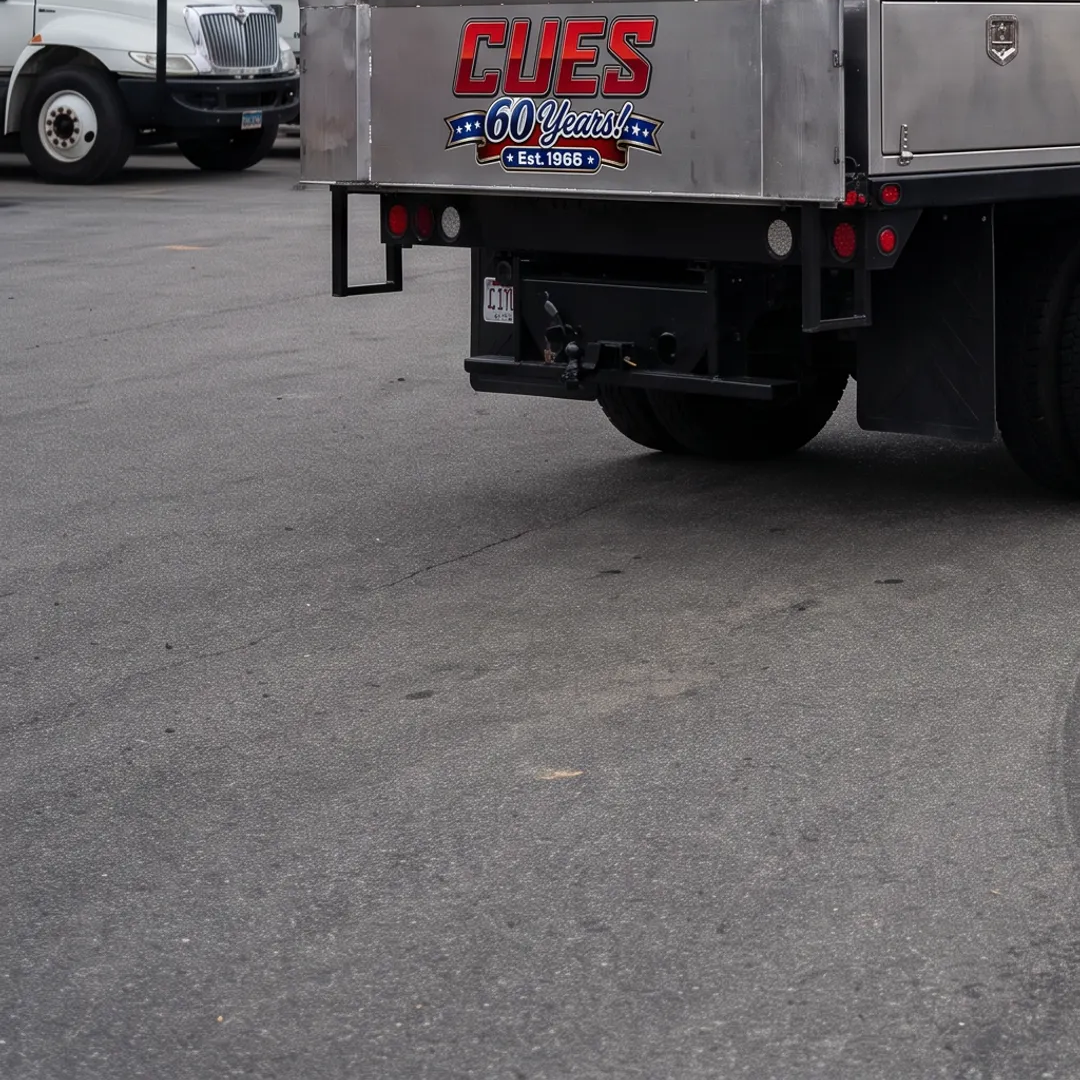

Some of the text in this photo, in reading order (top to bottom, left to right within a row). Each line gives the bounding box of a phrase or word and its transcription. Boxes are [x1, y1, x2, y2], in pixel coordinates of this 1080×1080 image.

[453, 16, 658, 97] CUES
[484, 96, 633, 148] 60 Years!
